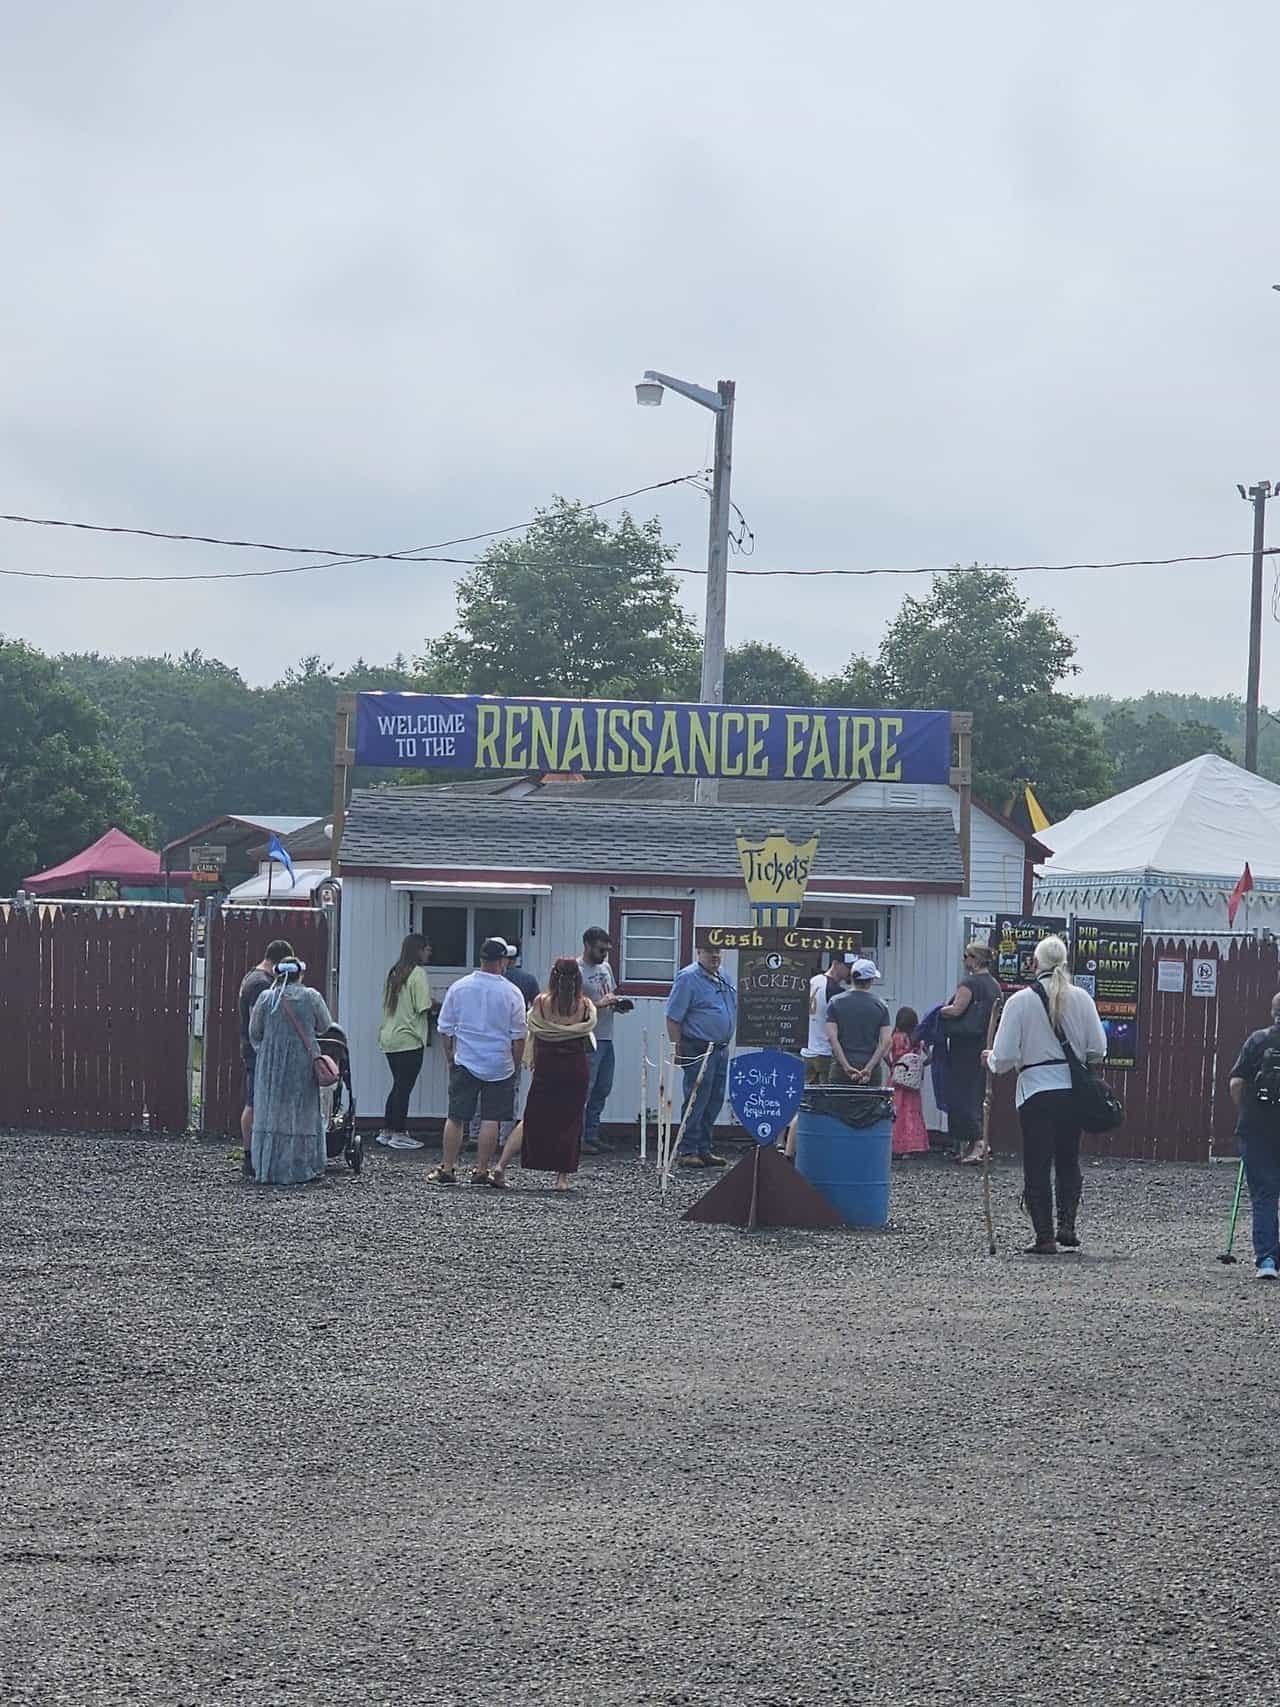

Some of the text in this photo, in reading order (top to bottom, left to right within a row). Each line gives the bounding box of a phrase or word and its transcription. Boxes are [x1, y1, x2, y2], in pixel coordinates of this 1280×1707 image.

[378, 714, 465, 736] WELCOME
[395, 737, 455, 758] TO THE
[474, 704, 902, 781] RENAISSANCE FAIRE
[742, 848, 810, 893] Tickets
[708, 928, 854, 950] Cash Credit
[1098, 959, 1130, 972] PARTY
[740, 974, 807, 992] TICKETS
[745, 1066, 779, 1088] Shirt
[743, 1105, 782, 1119] Required
[744, 1093, 781, 1110] Shoes
